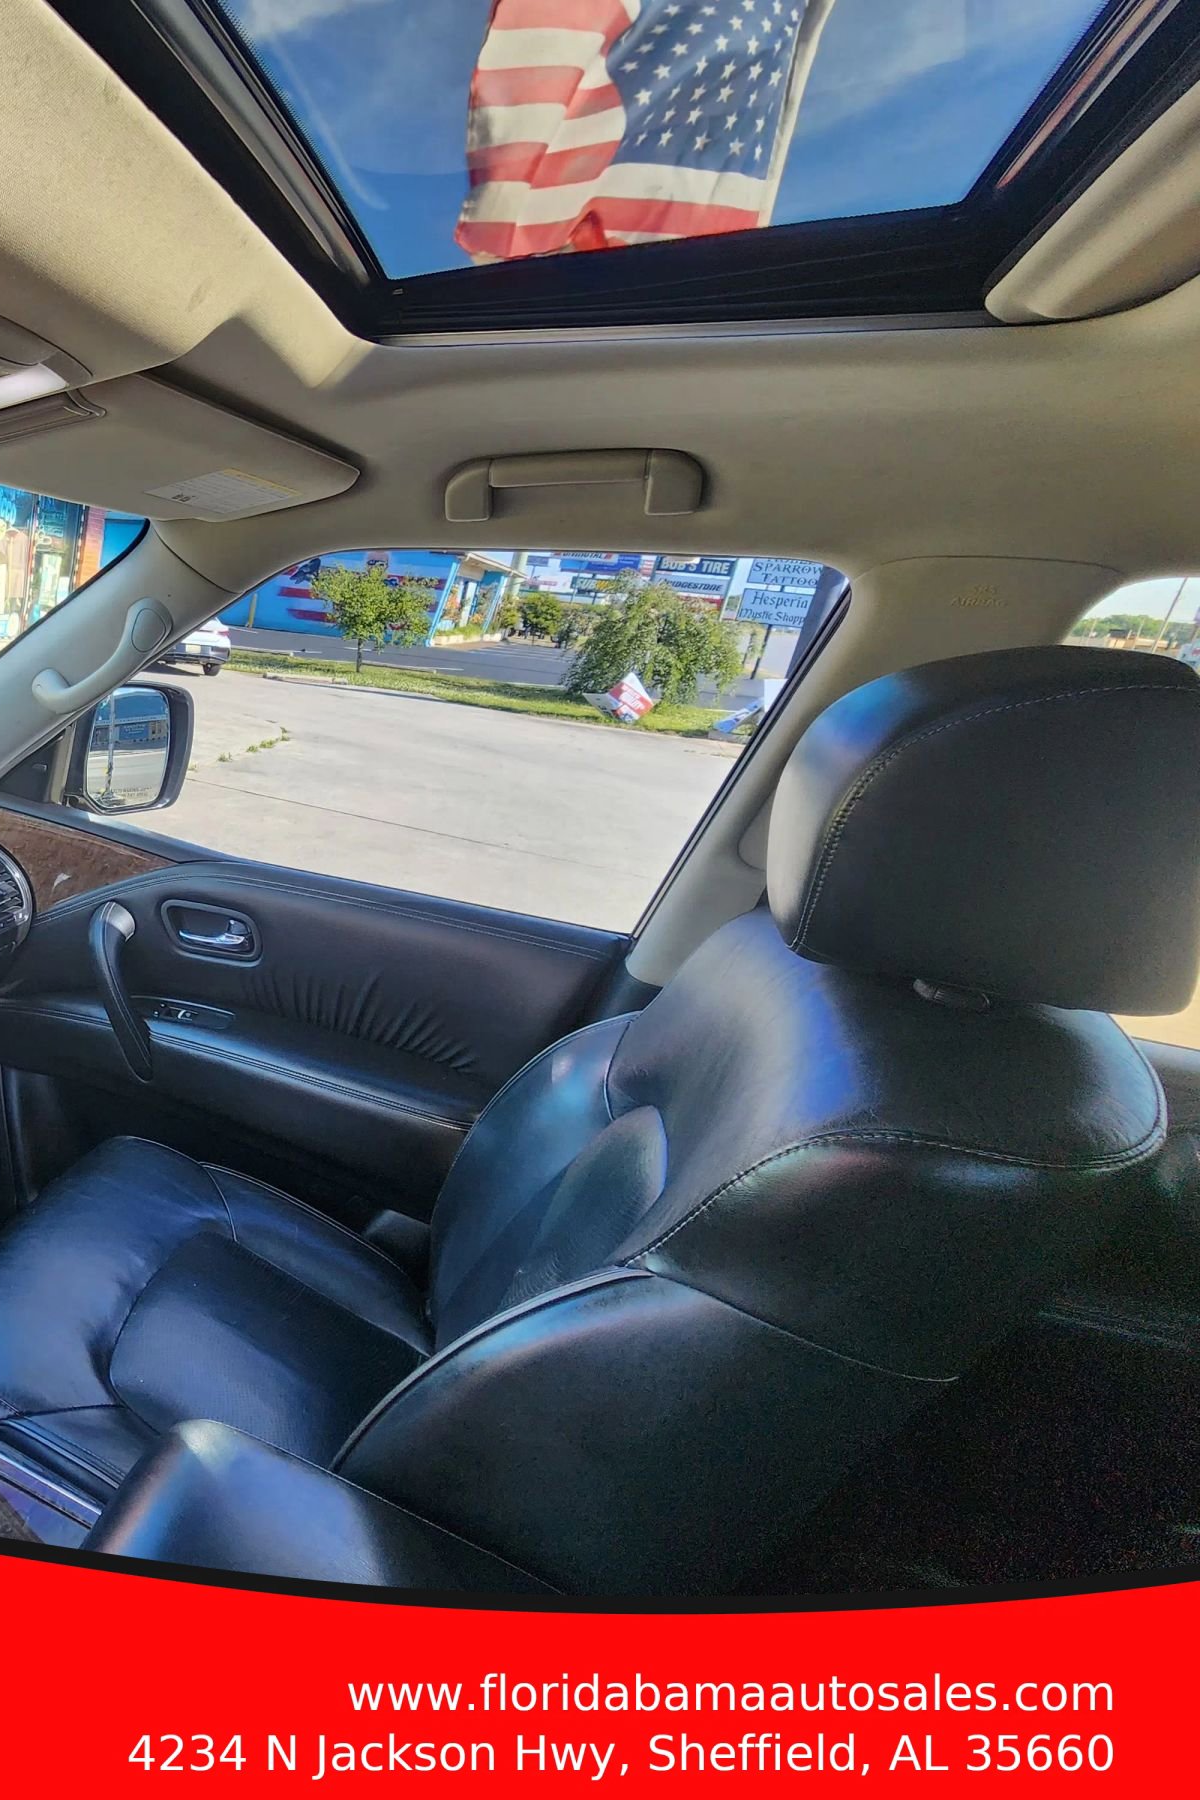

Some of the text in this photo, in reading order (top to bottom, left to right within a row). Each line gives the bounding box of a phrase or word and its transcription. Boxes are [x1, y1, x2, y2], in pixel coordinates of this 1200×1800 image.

[701, 560, 731, 575] TIRE
[752, 561, 823, 575] SPARROW
[761, 572, 819, 587] TATTOO
[751, 591, 809, 609] Hesperia
[739, 608, 773, 623] Mystic
